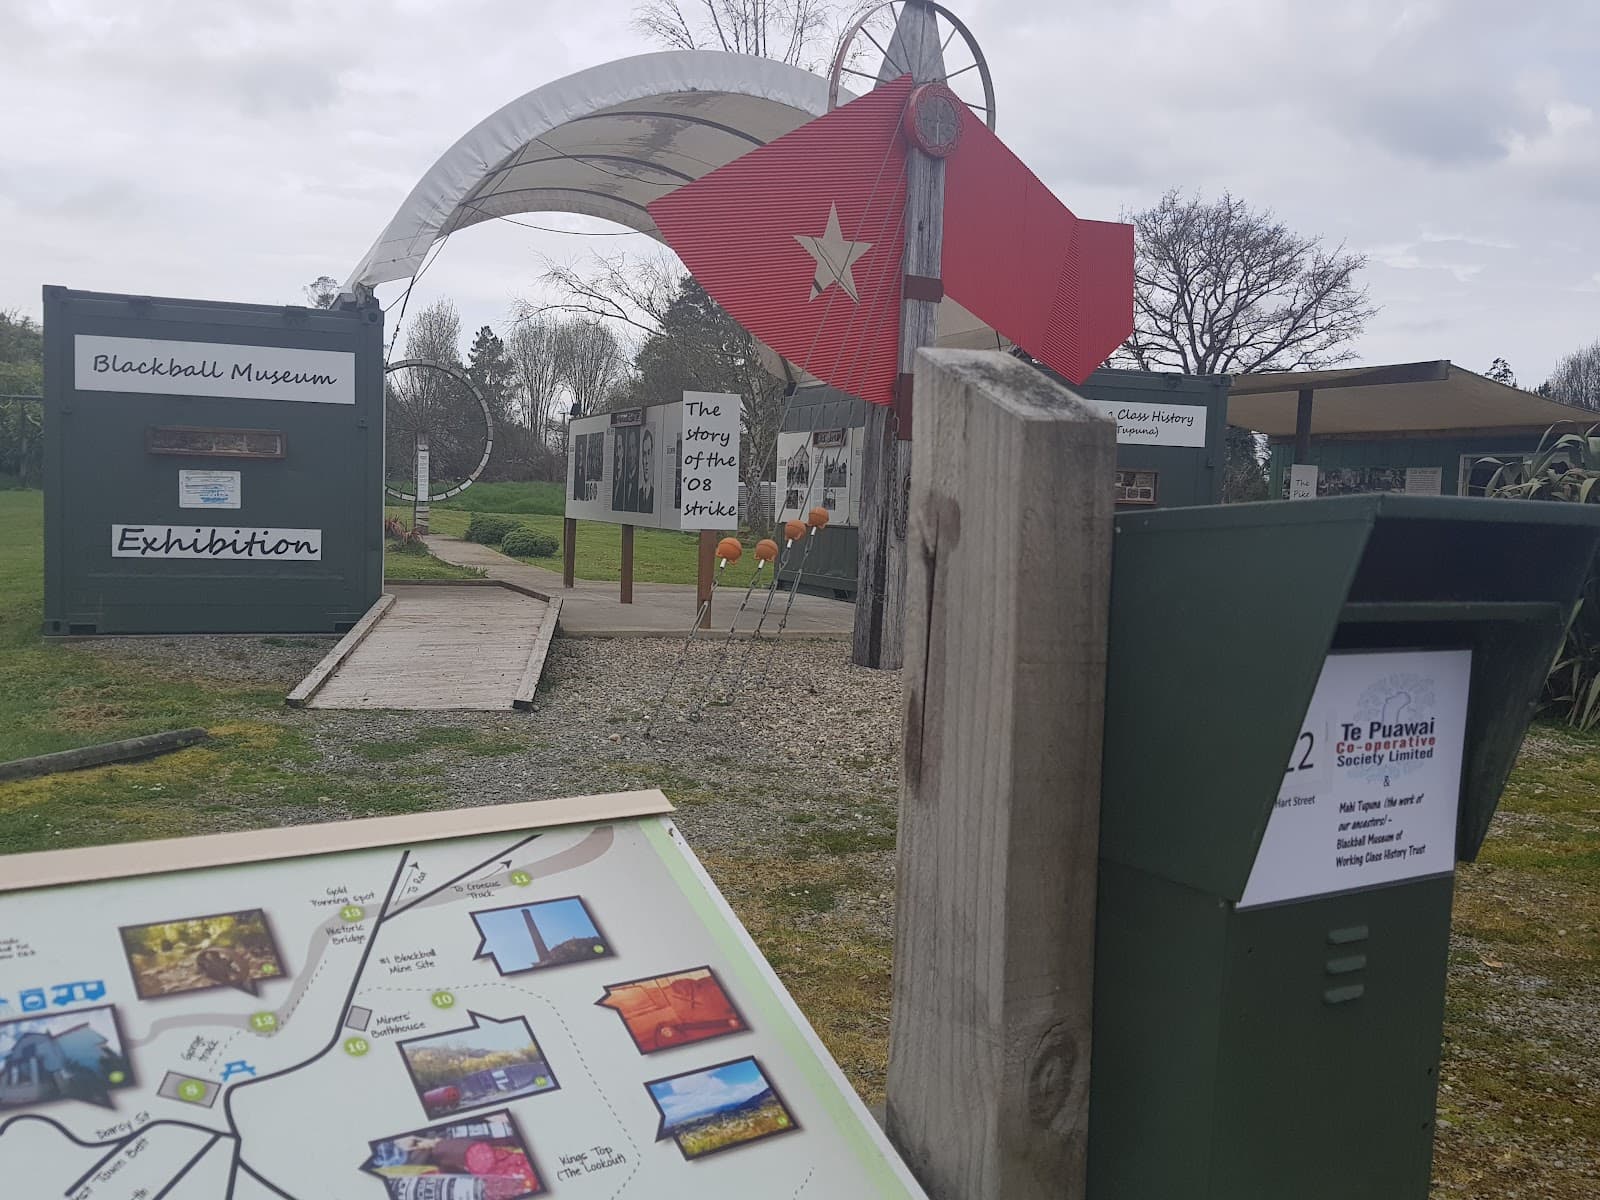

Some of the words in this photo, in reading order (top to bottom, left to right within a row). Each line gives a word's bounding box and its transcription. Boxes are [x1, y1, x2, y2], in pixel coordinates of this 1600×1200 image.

[93, 354, 224, 379] Blackball
[230, 363, 338, 385] Museum
[685, 401, 722, 416] The
[1117, 408, 1150, 421] Class
[1152, 410, 1195, 427] History
[685, 426, 731, 448] story
[684, 451, 705, 470] of
[706, 452, 737, 468] the
[683, 476, 712, 491] '08
[684, 500, 737, 516] strike
[117, 527, 319, 556] Exhibition
[1341, 722, 1362, 741] Te
[1368, 717, 1436, 739] Puawai
[1336, 736, 1436, 755] Co-operative
[1336, 752, 1384, 767] Society
[1389, 747, 1434, 762] Limited
[1383, 775, 1391, 787] &
[1293, 796, 1316, 807] Street
[1339, 801, 1356, 813] Mahi
[1398, 794, 1415, 806] work
[1416, 793, 1424, 804] of
[1338, 822, 1351, 832] our
[1336, 835, 1366, 850] Blackball
[1367, 834, 1394, 845] Museum
[1395, 830, 1404, 841] of
[1336, 854, 1363, 868] Working
[1365, 852, 1382, 863] Class
[1383, 848, 1407, 860] History
[1408, 844, 1426, 856] Trust
[513, 873, 530, 884] 11
[393, 948, 437, 964] Blackball
[389, 965, 413, 976] Mine
[415, 959, 436, 970] Site
[434, 993, 453, 1006] 10
[589, 1145, 614, 1159] Top
